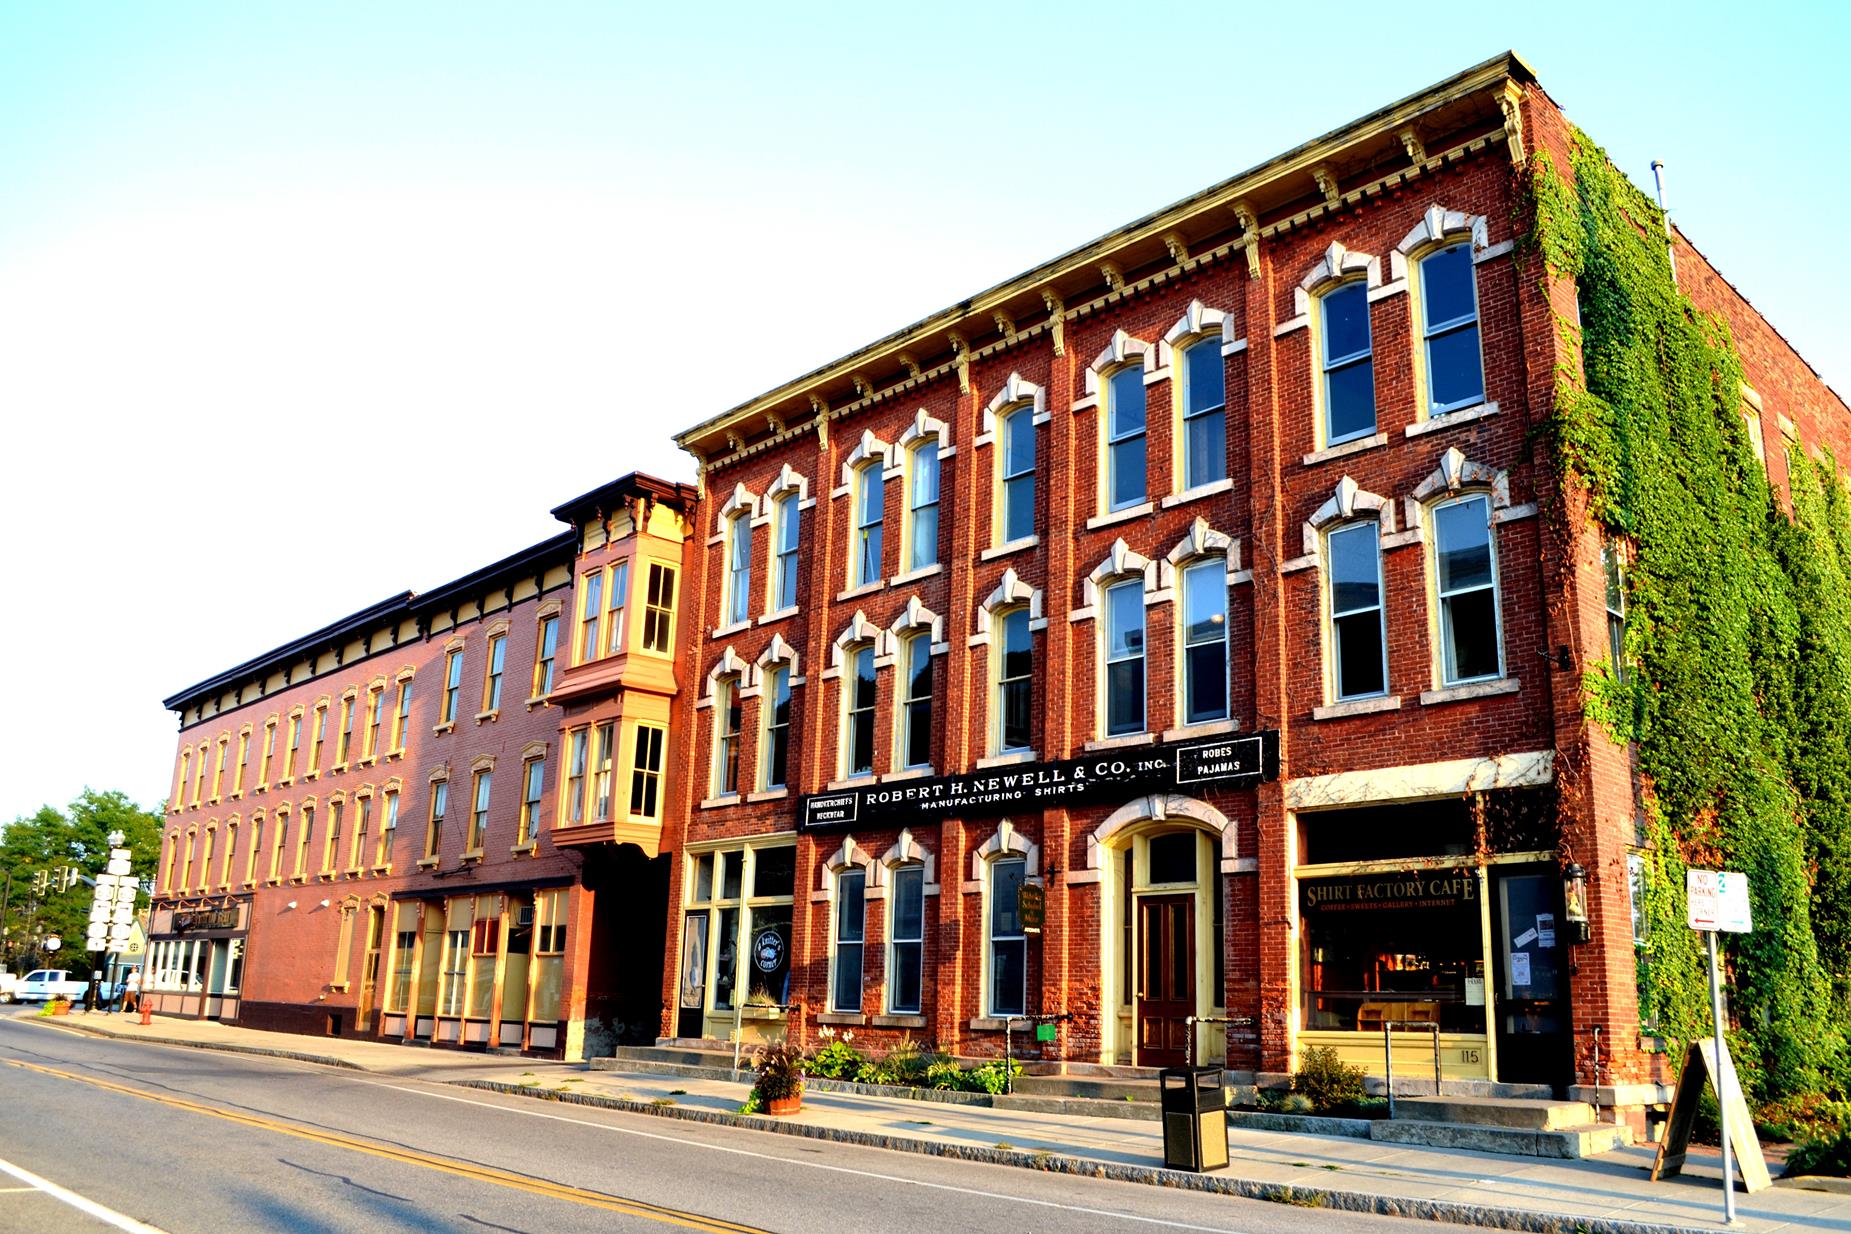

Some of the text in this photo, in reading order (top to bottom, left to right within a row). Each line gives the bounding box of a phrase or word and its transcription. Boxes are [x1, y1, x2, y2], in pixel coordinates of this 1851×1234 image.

[1202, 747, 1232, 759] ROBES
[1197, 761, 1240, 775] PAJAMAS
[866, 784, 943, 805] ROBERT
[951, 782, 968, 795] H.
[973, 769, 1065, 793] NEWELL
[1073, 766, 1086, 779] &
[1095, 761, 1131, 776] CO.
[921, 783, 1085, 810] MANUFACTURING SHIRTS
[816, 810, 845, 820] NECKWEAR
[1697, 874, 1708, 885] NO
[1307, 878, 1475, 907] SHIRT FACTORY CAFE
[1382, 901, 1413, 909] GALLERY
[1419, 899, 1456, 907] INTERNET
[1461, 1050, 1479, 1063] 115
